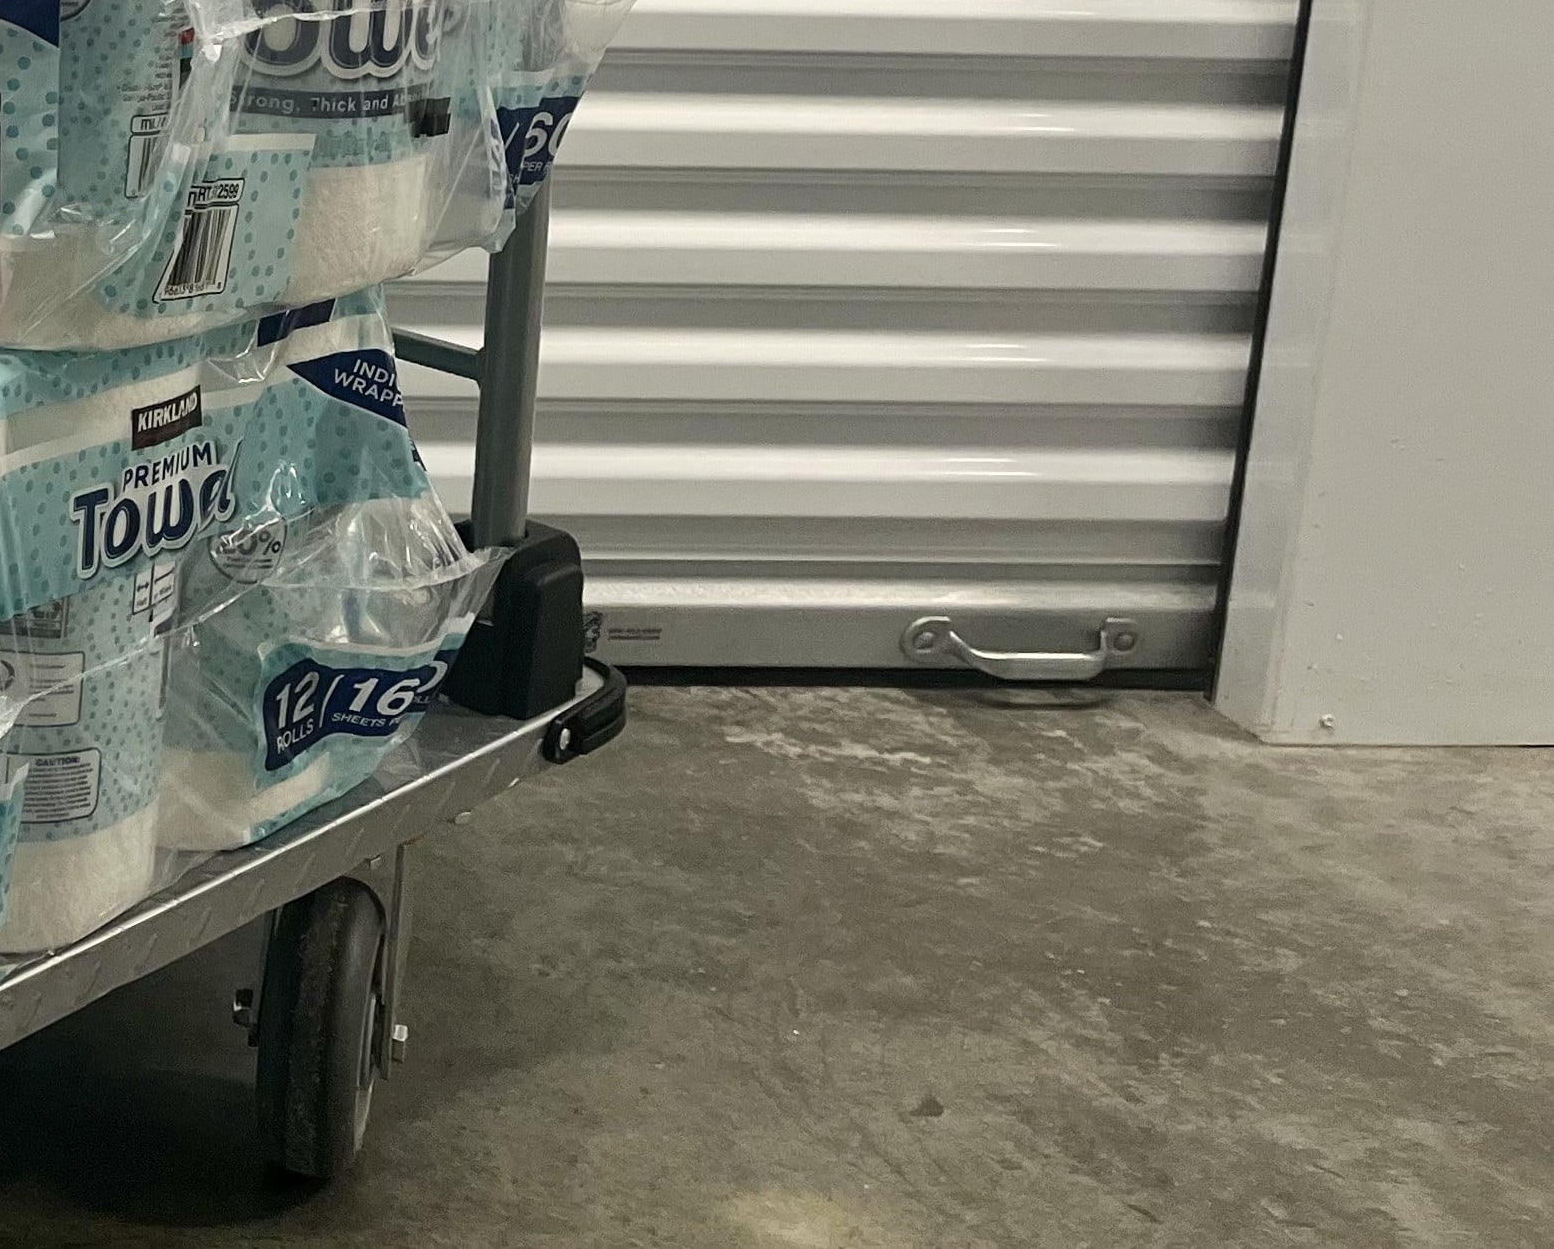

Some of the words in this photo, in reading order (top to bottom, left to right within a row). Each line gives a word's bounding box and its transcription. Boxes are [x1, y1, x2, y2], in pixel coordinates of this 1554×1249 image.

[363, 95, 387, 111] and
[138, 393, 198, 433] KIRKLAND
[123, 442, 212, 493] PREMIUM
[276, 671, 320, 730] 12
[276, 718, 314, 754] ROLLS
[331, 712, 386, 727] SHEETS
